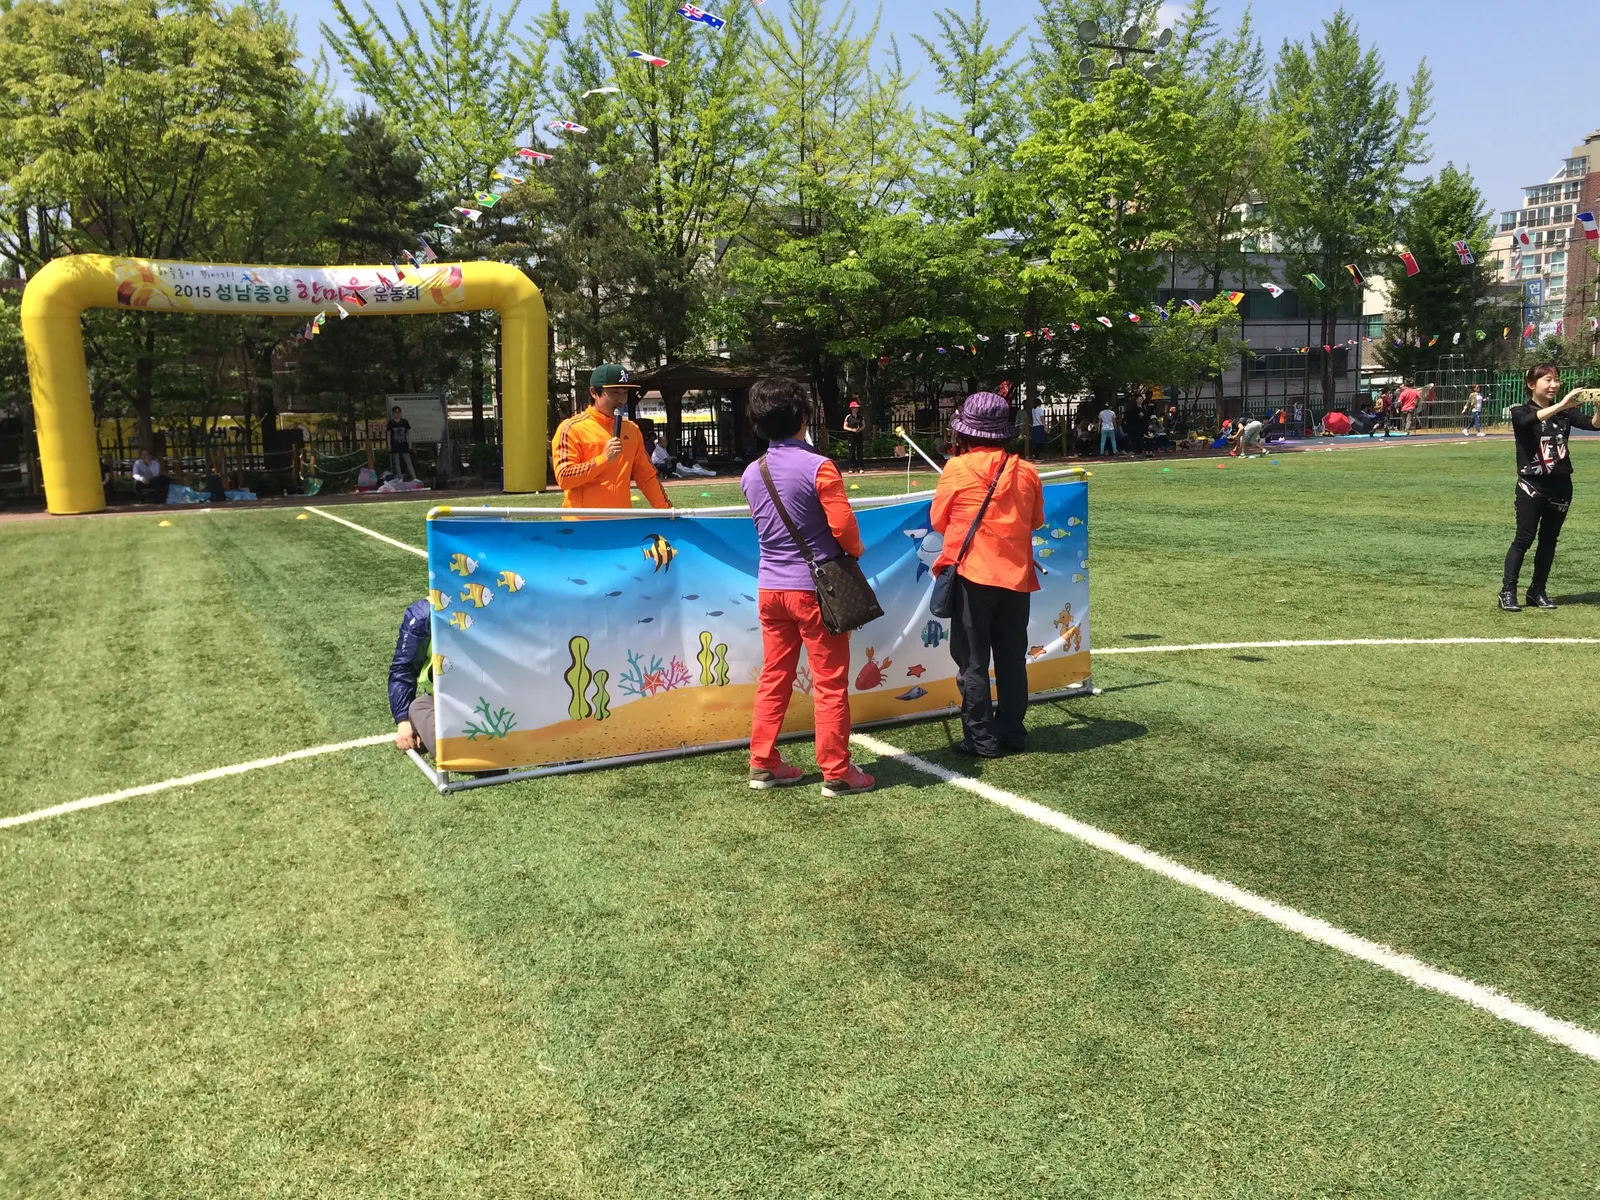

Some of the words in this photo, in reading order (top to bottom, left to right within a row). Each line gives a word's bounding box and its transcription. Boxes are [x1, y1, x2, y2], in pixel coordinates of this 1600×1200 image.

[174, 284, 211, 299] 2015
[215, 284, 291, 304] 성남중앙
[373, 285, 420, 302] 운동회
